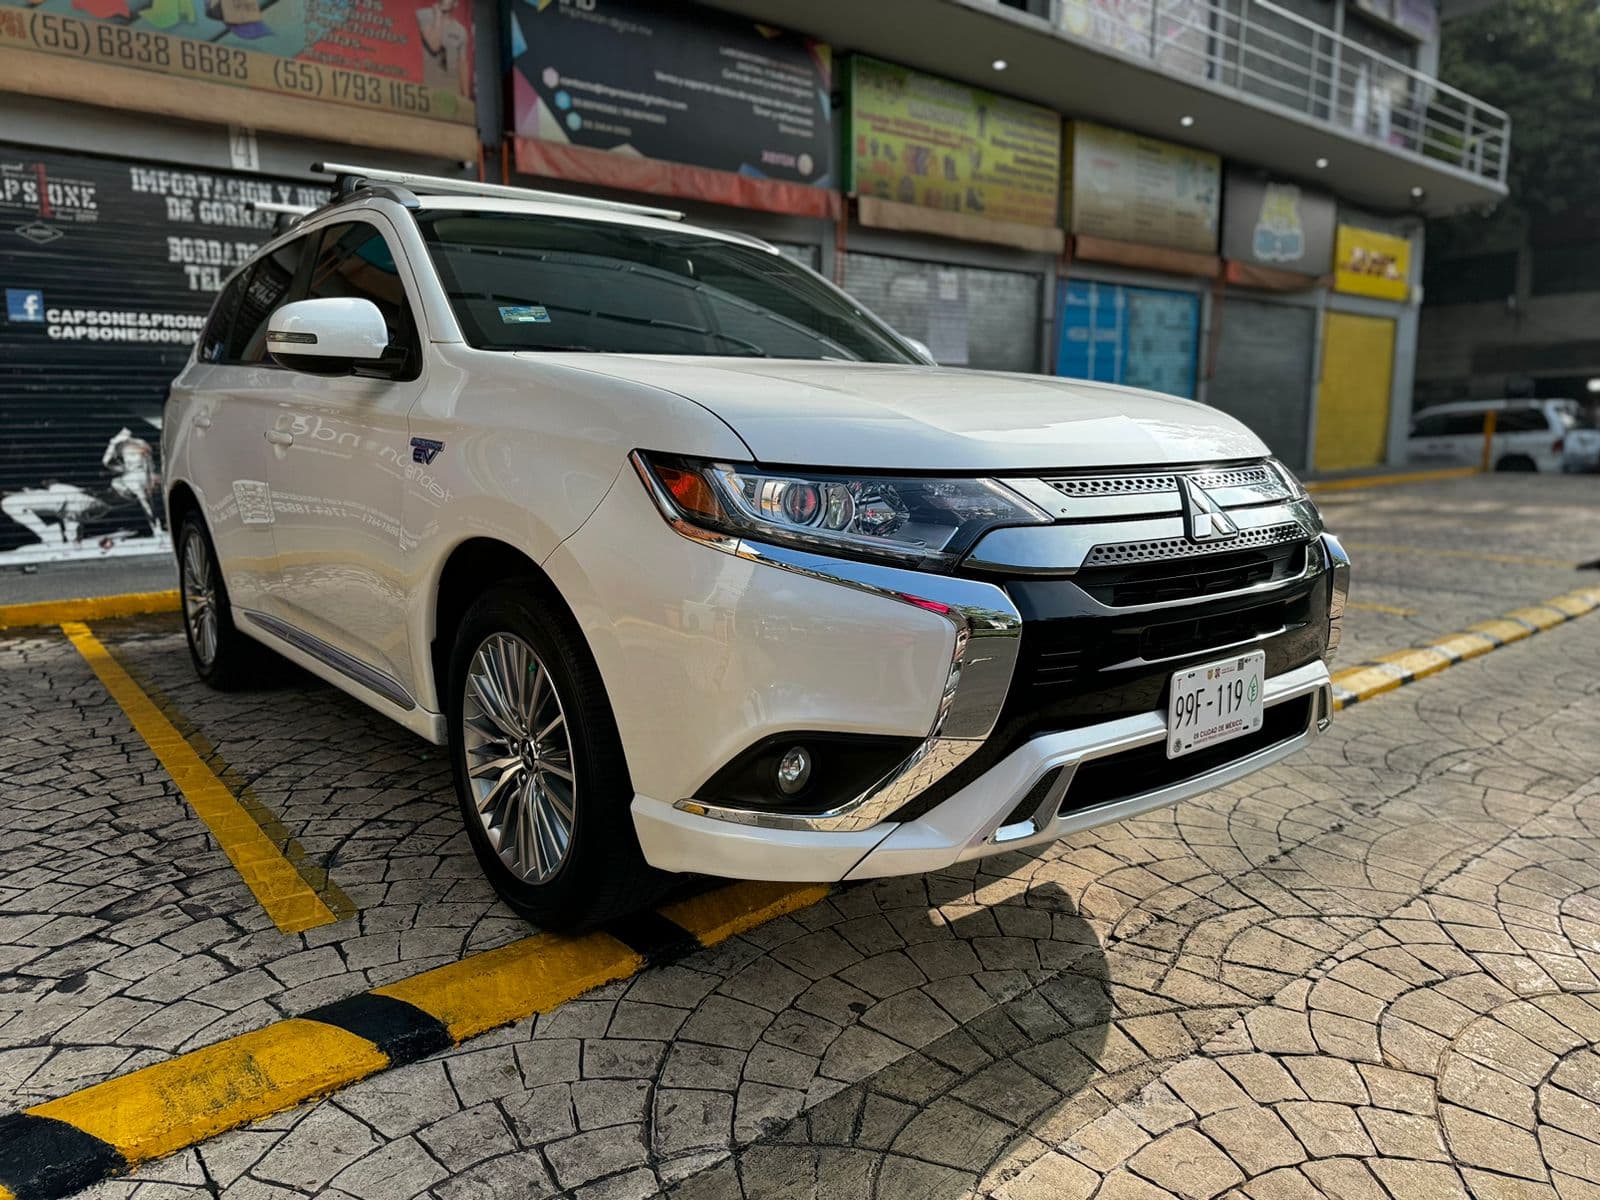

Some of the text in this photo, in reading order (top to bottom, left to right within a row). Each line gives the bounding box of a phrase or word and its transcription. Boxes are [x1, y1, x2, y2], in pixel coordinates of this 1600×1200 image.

[30, 13, 90, 55] (55)
[97, 25, 170, 66] 6838
[181, 40, 248, 80] 6683
[273, 58, 323, 96] (55)
[331, 69, 382, 104] 1793
[389, 83, 430, 113] 1155
[129, 167, 331, 209] IMPORTACION Y DIS
[165, 196, 195, 221] DE
[413, 446, 440, 465] EV
[1175, 678, 1243, 730] 99F-119
